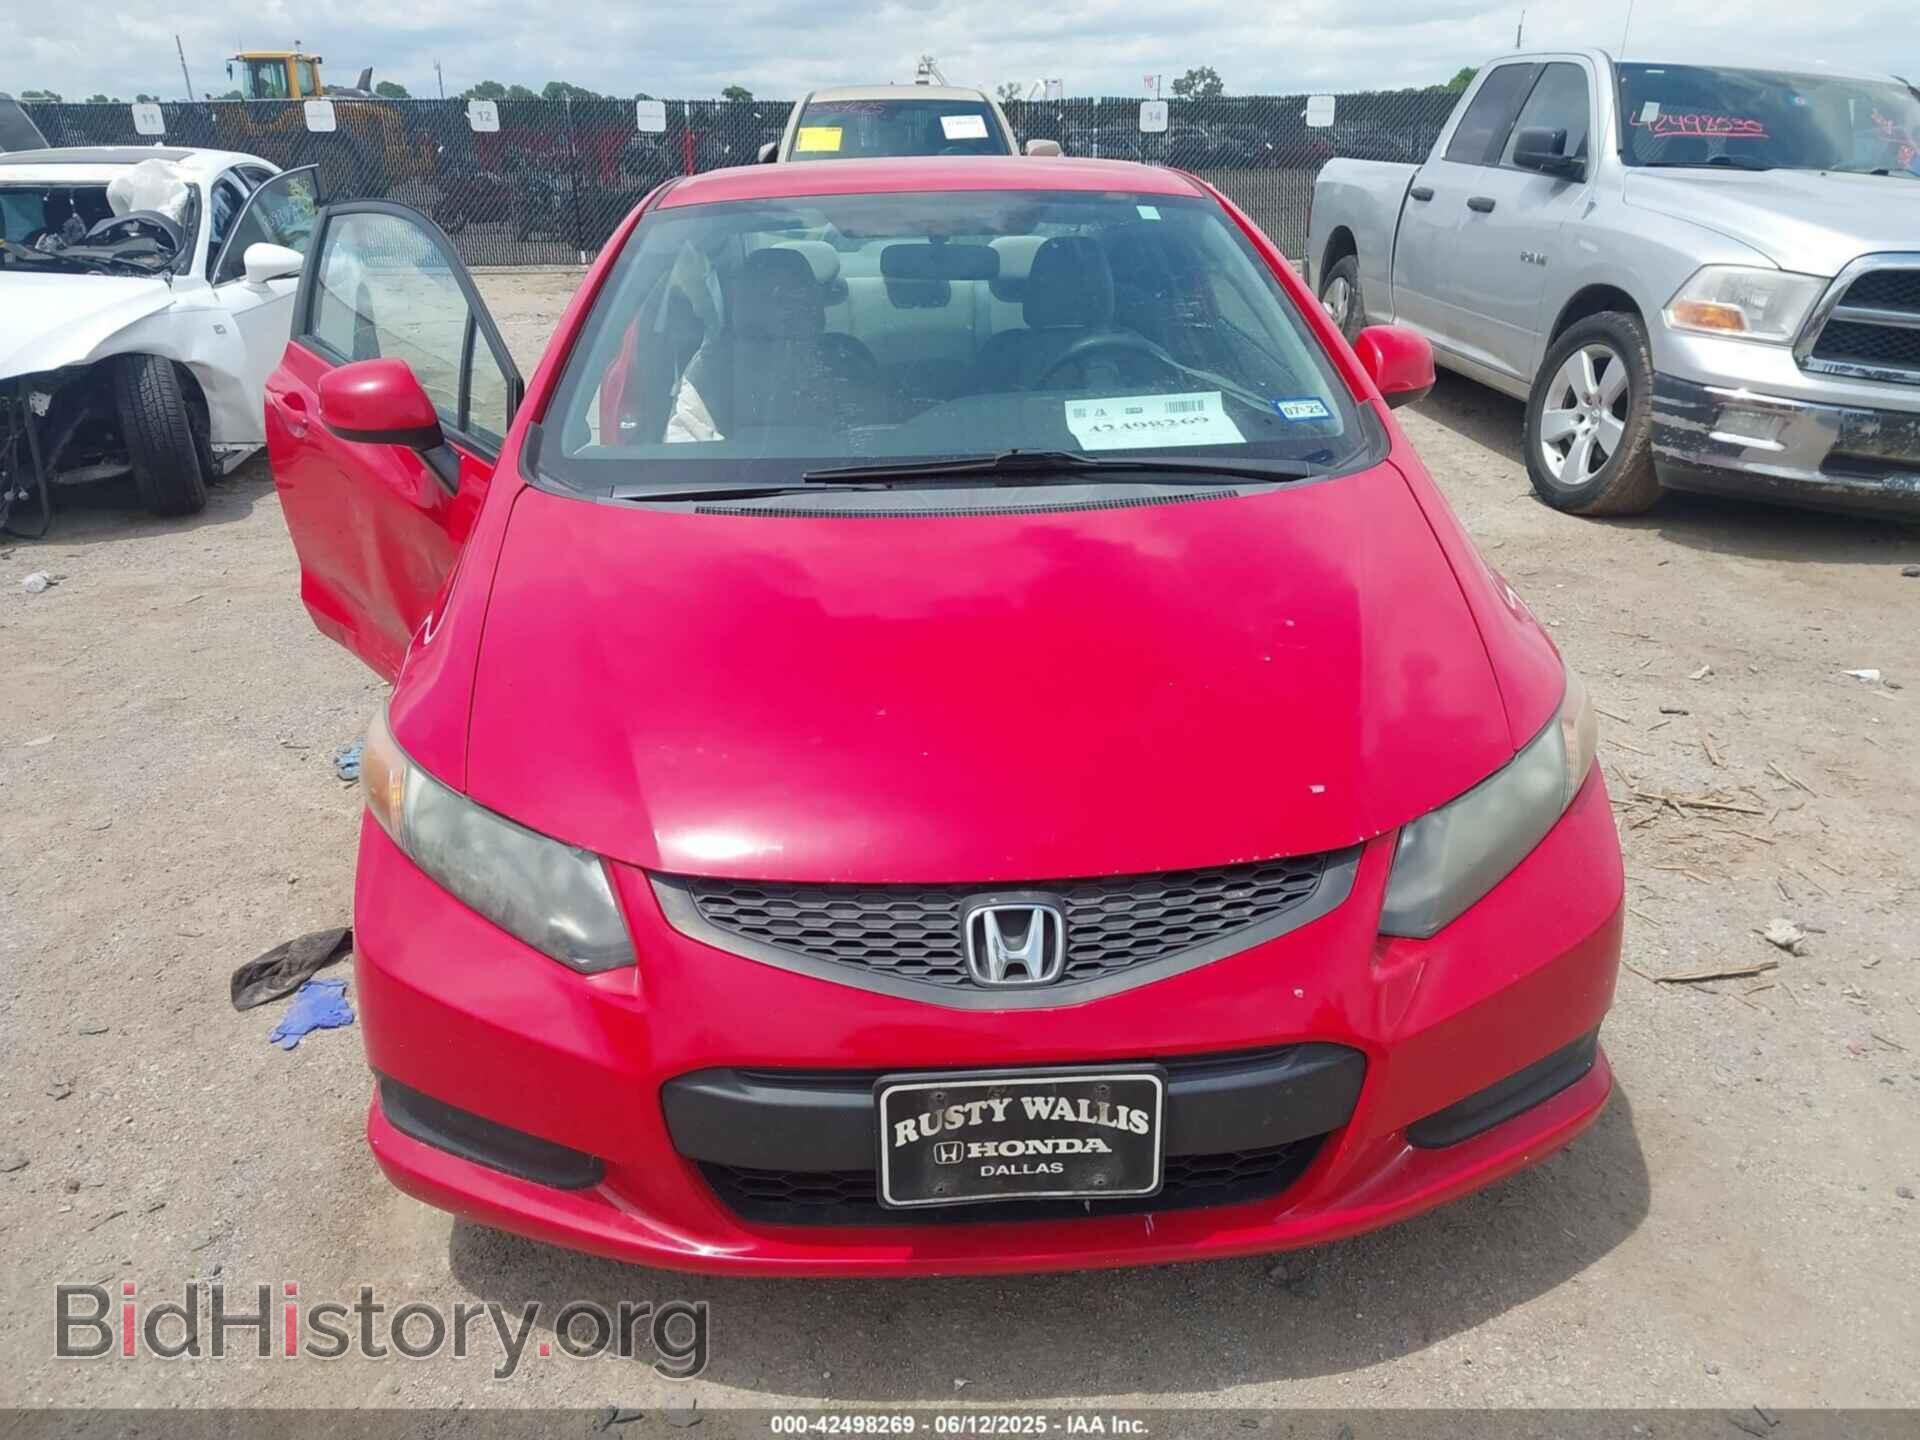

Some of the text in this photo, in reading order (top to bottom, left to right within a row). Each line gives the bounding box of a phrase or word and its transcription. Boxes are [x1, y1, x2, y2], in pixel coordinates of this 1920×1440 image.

[894, 1095, 1150, 1147] RUSTY WALLIS
[967, 1138, 1113, 1158] HONDA
[980, 1162, 1064, 1177] DALLAS
